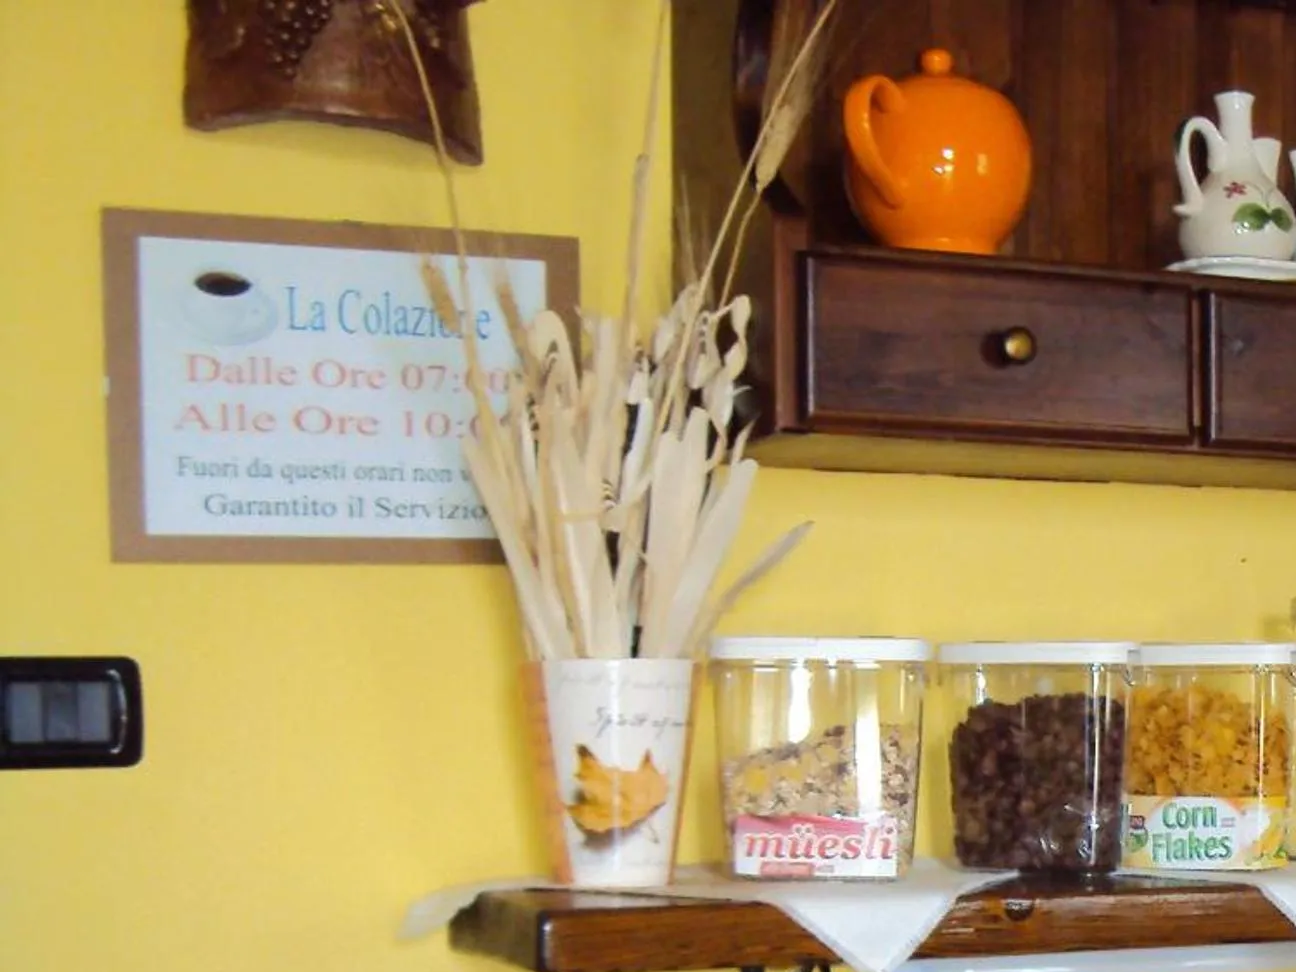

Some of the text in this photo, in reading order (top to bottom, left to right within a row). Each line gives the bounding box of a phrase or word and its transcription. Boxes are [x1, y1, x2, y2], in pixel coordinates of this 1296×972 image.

[286, 286, 492, 340] La Colazie
[184, 353, 298, 389] Dalle
[311, 359, 387, 390] Ore
[173, 402, 277, 434] Alle
[294, 405, 380, 436] Ore
[176, 455, 239, 482] Fuori
[246, 456, 273, 479] da
[280, 459, 346, 484] questi
[353, 462, 404, 483] orari
[412, 464, 452, 484] non
[203, 493, 489, 521] Garantito il Servizio
[1162, 802, 1218, 830] Corn
[744, 823, 895, 861] müesli
[1151, 831, 1234, 863] Flakes
